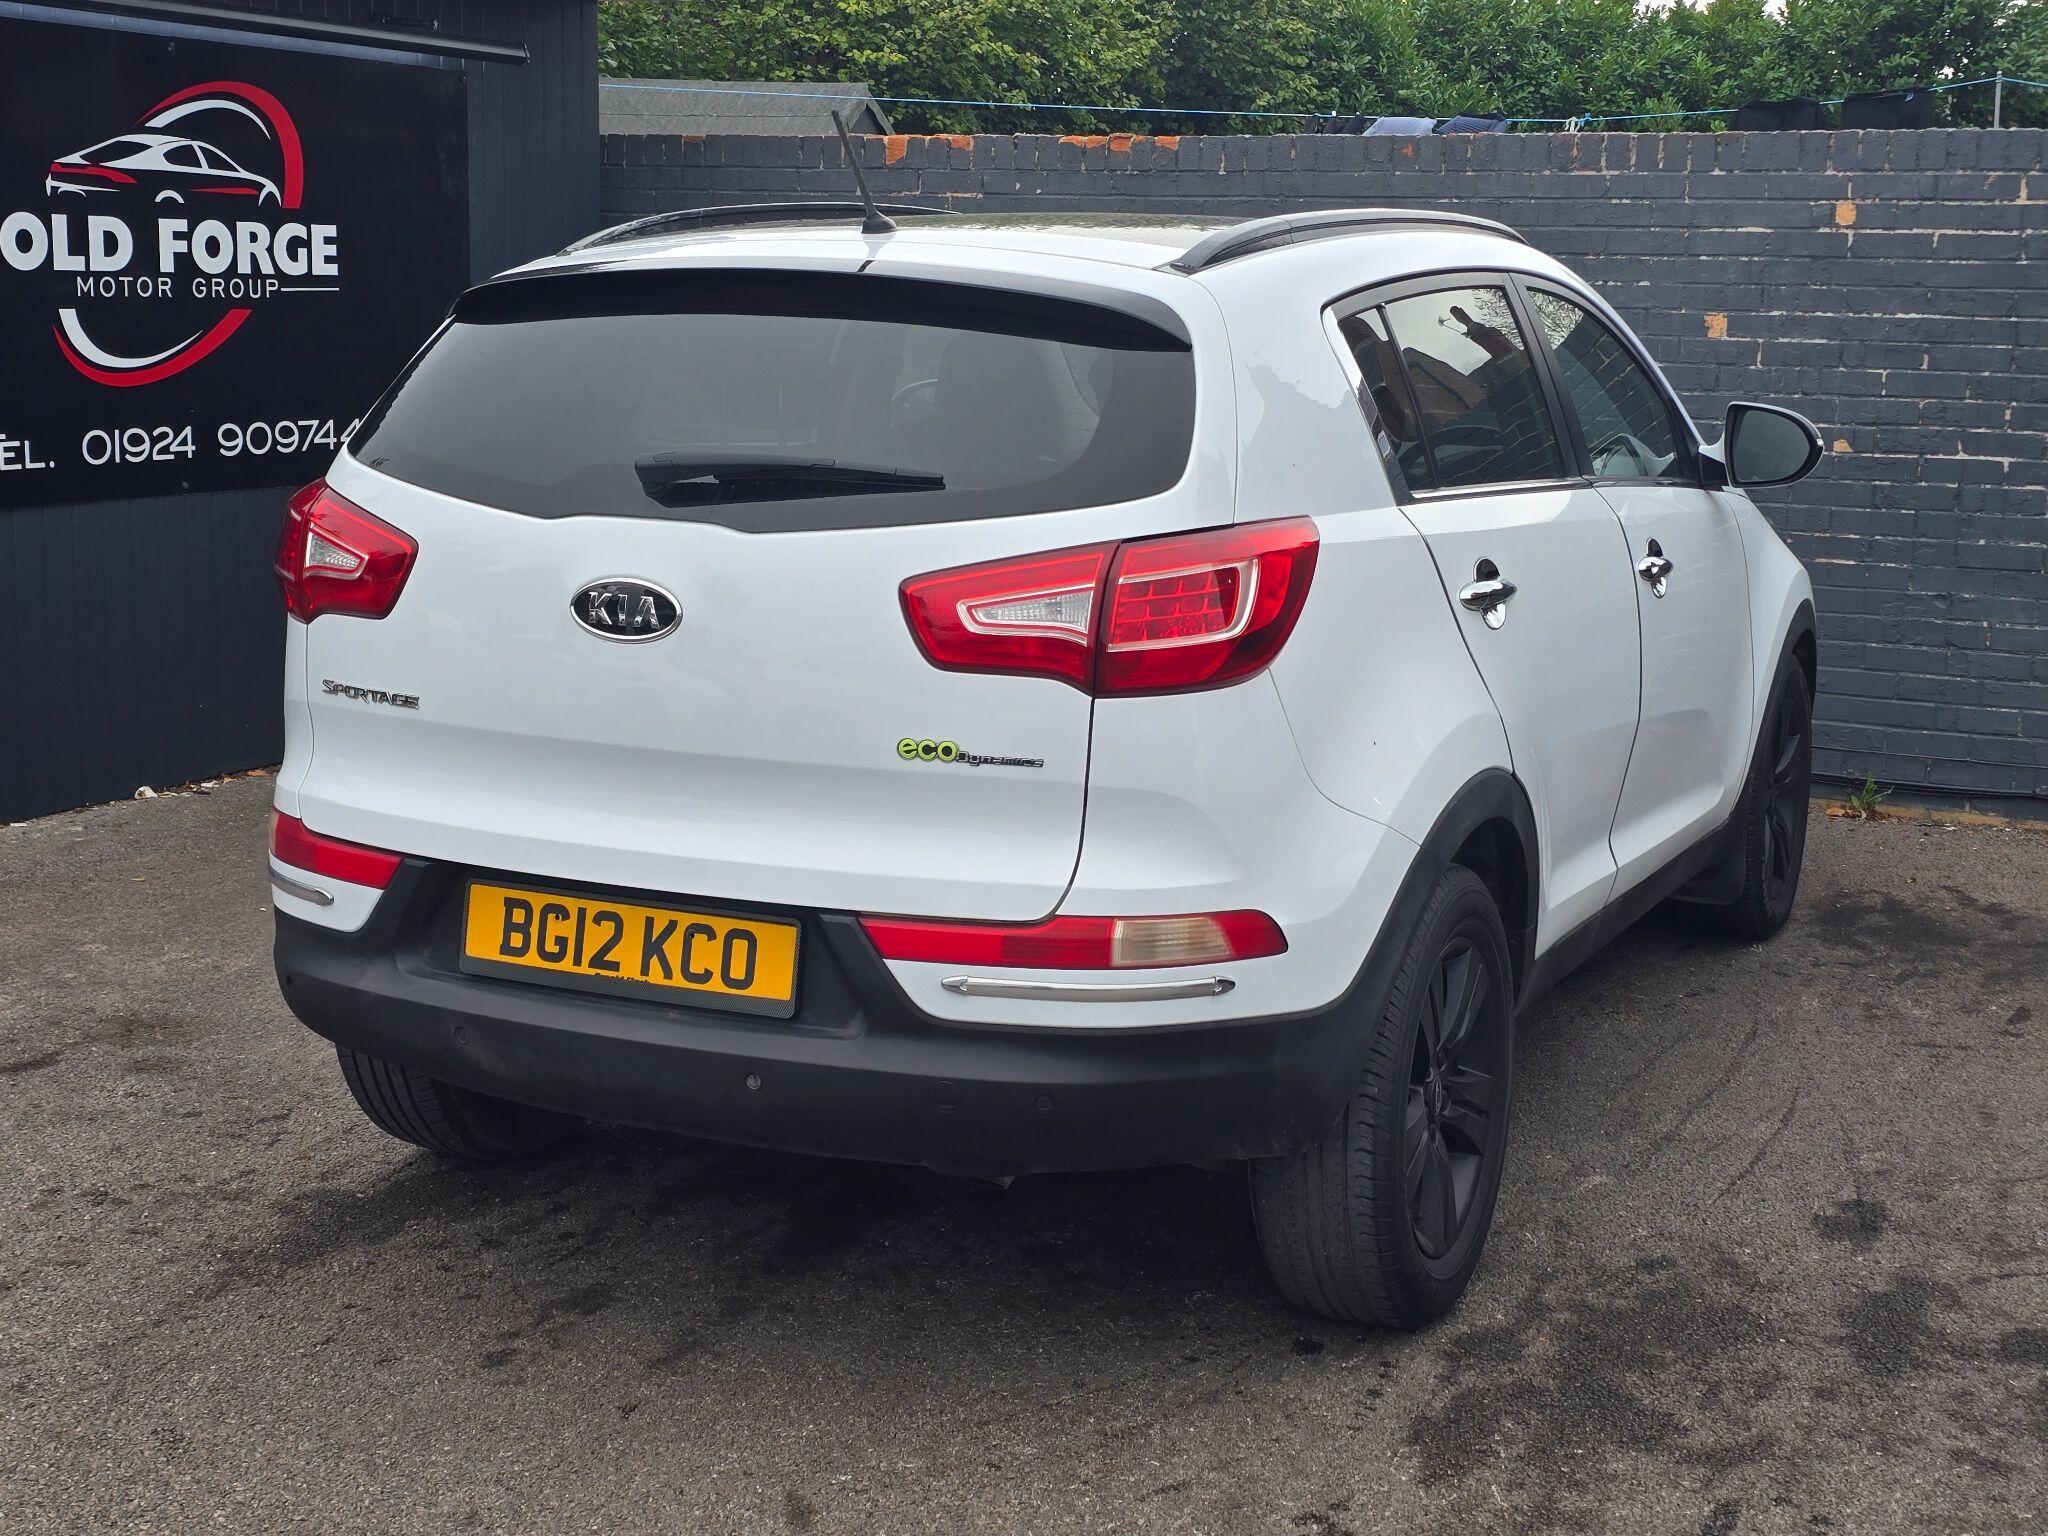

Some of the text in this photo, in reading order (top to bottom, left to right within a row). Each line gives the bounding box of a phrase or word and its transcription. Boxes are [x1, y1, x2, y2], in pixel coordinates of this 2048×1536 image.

[0, 211, 339, 277] OLD FORGE
[77, 276, 280, 299] MOTOR GROUP
[82, 424, 196, 465] 01924
[588, 591, 661, 630] KIA
[499, 896, 758, 991] BG12 KCO
